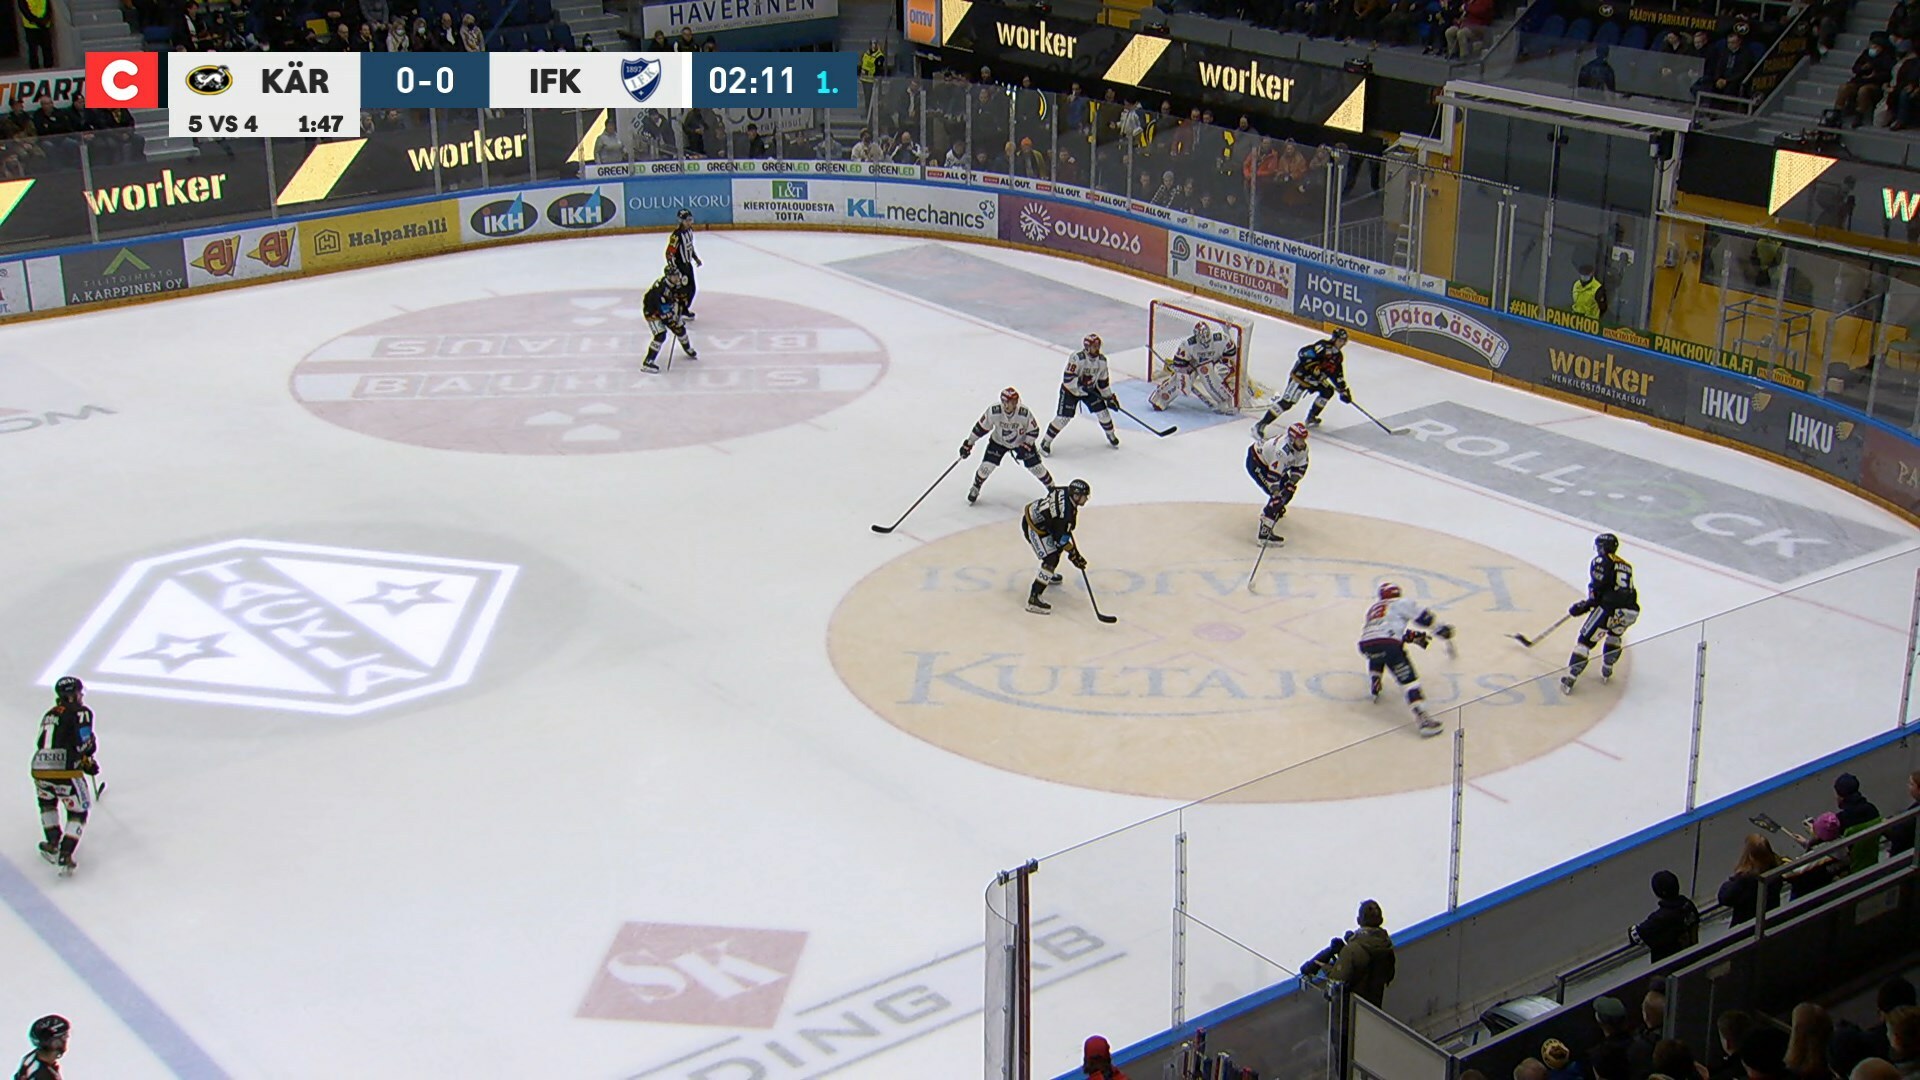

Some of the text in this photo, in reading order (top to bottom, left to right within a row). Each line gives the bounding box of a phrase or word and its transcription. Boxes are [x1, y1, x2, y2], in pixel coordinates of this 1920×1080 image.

[910, 9, 933, 27] omv
[996, 20, 1077, 60] worker
[1199, 60, 1294, 103] worker
[407, 130, 527, 172] worker
[777, 181, 804, 198] L&T
[945, 172, 960, 181] ALL
[83, 169, 228, 216] worker
[629, 194, 731, 212] OULUN KORU
[743, 201, 835, 213] KIERTOTALOUDESTA
[1101, 195, 1112, 208] ALL
[775, 212, 805, 222] TOTTA
[1144, 205, 1157, 217] ALL
[347, 217, 448, 249] HalpaHalli
[1054, 219, 1141, 255] OULU2026
[166, 278, 184, 289] OY
[1207, 264, 1276, 294] TERVETULOA!
[1308, 272, 1363, 304] HOTEL
[1300, 294, 1368, 328] APOLLO
[364, 367, 813, 396] BAUHAUS
[1549, 347, 1655, 397] worker
[1701, 385, 1750, 425] IHKU
[1788, 411, 1834, 455] IHKU
[178, 557, 432, 697] TACKLA
[77, 711, 91, 724] 71
